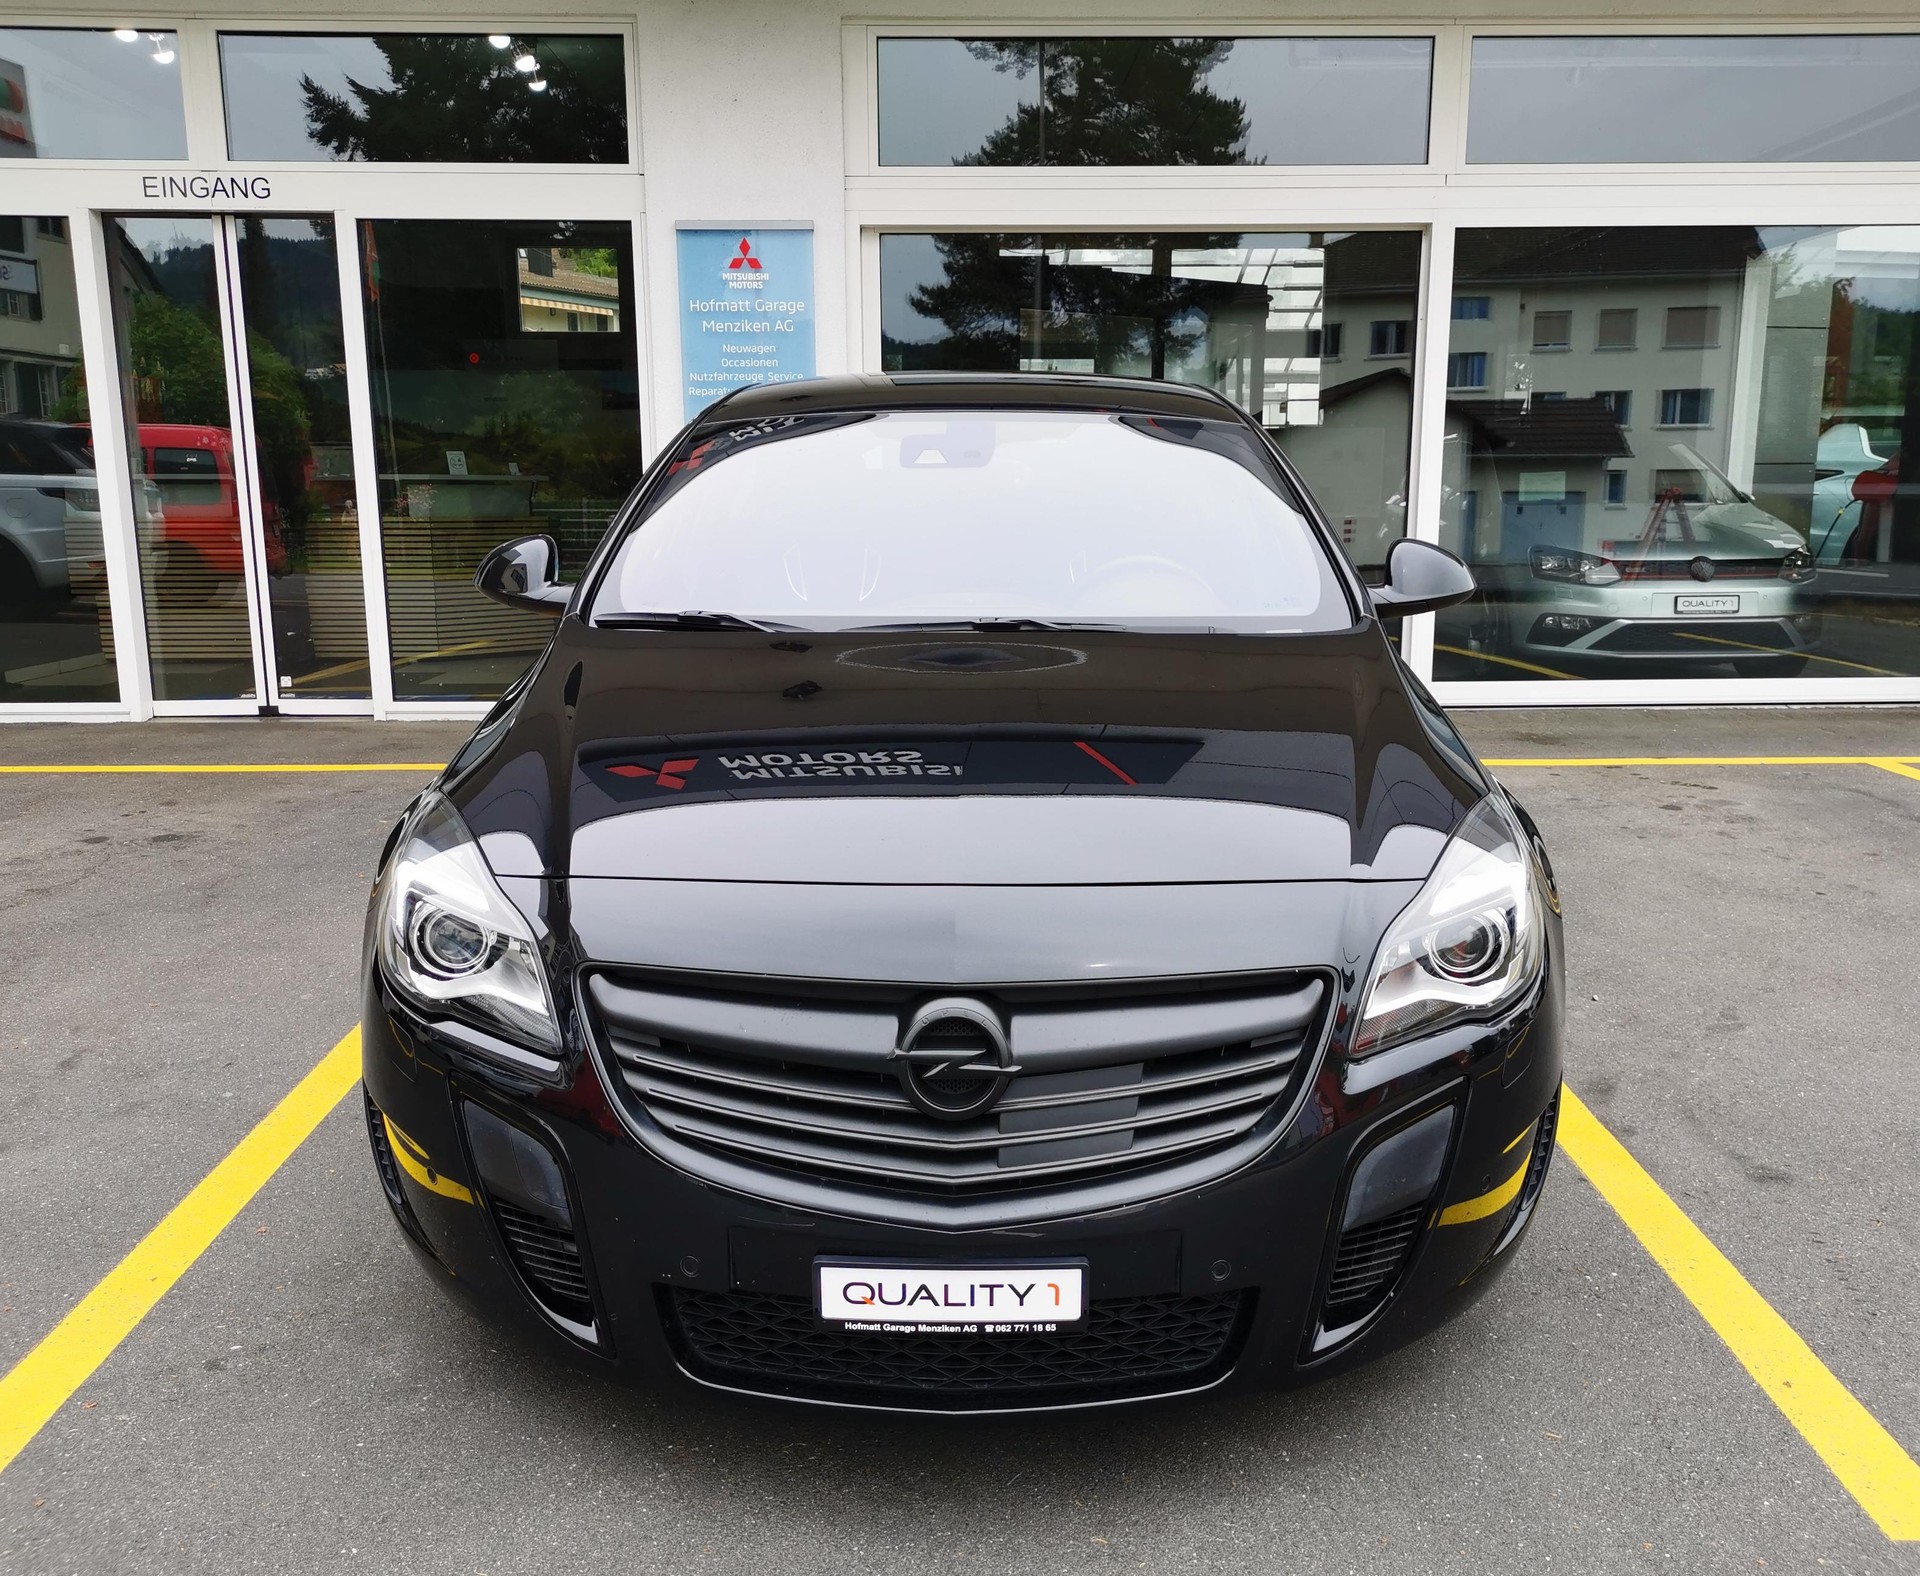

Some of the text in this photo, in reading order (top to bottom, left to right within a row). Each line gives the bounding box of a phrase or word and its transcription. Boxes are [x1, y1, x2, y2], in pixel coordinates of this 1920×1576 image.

[142, 176, 271, 199] EINGANG
[722, 273, 769, 281] MITSUBISHI
[729, 281, 763, 289] MOTORS
[689, 299, 805, 315] Hofmatt Garage
[702, 320, 794, 333] Menziken AG
[722, 344, 776, 355] Neuwagen
[721, 358, 778, 368] Occasionen
[689, 372, 804, 383] Nutzfahrzeuge Service
[842, 1281, 1060, 1306] QUALITY 1
[845, 1322, 881, 1331] Hofmatt
[883, 1323, 915, 1333] Garage
[918, 1324, 961, 1332] Menziken
[1014, 1324, 1030, 1332] 771
[1033, 1324, 1043, 1332] 18
